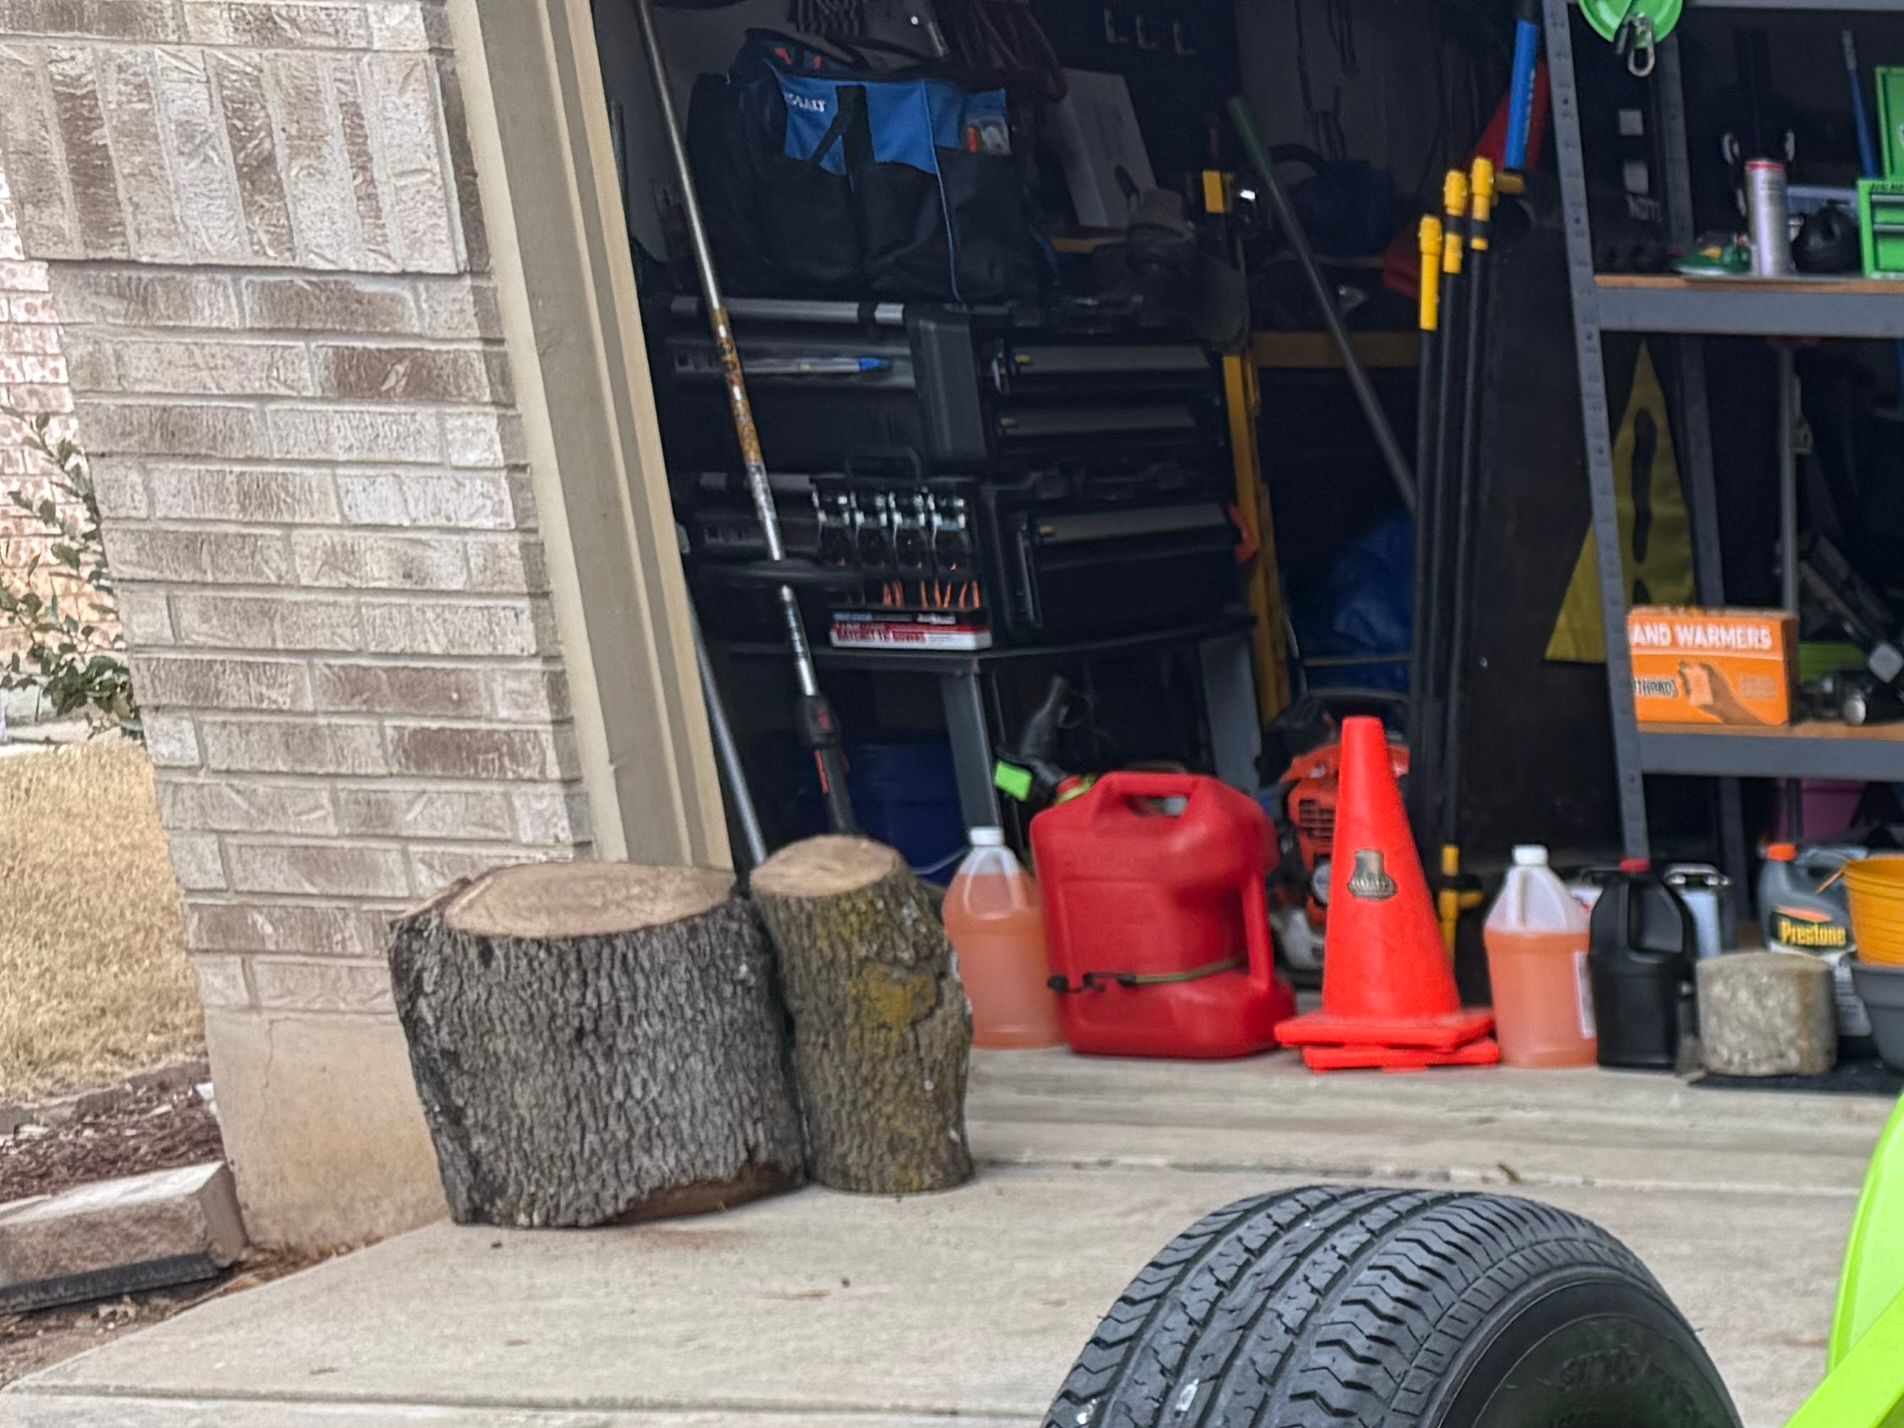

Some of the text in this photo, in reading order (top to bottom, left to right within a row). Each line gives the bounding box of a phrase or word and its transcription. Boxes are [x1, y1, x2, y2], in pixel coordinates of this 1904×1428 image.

[1630, 623, 1773, 649] AND WARMERS
[1778, 920, 1847, 946] Prestone
